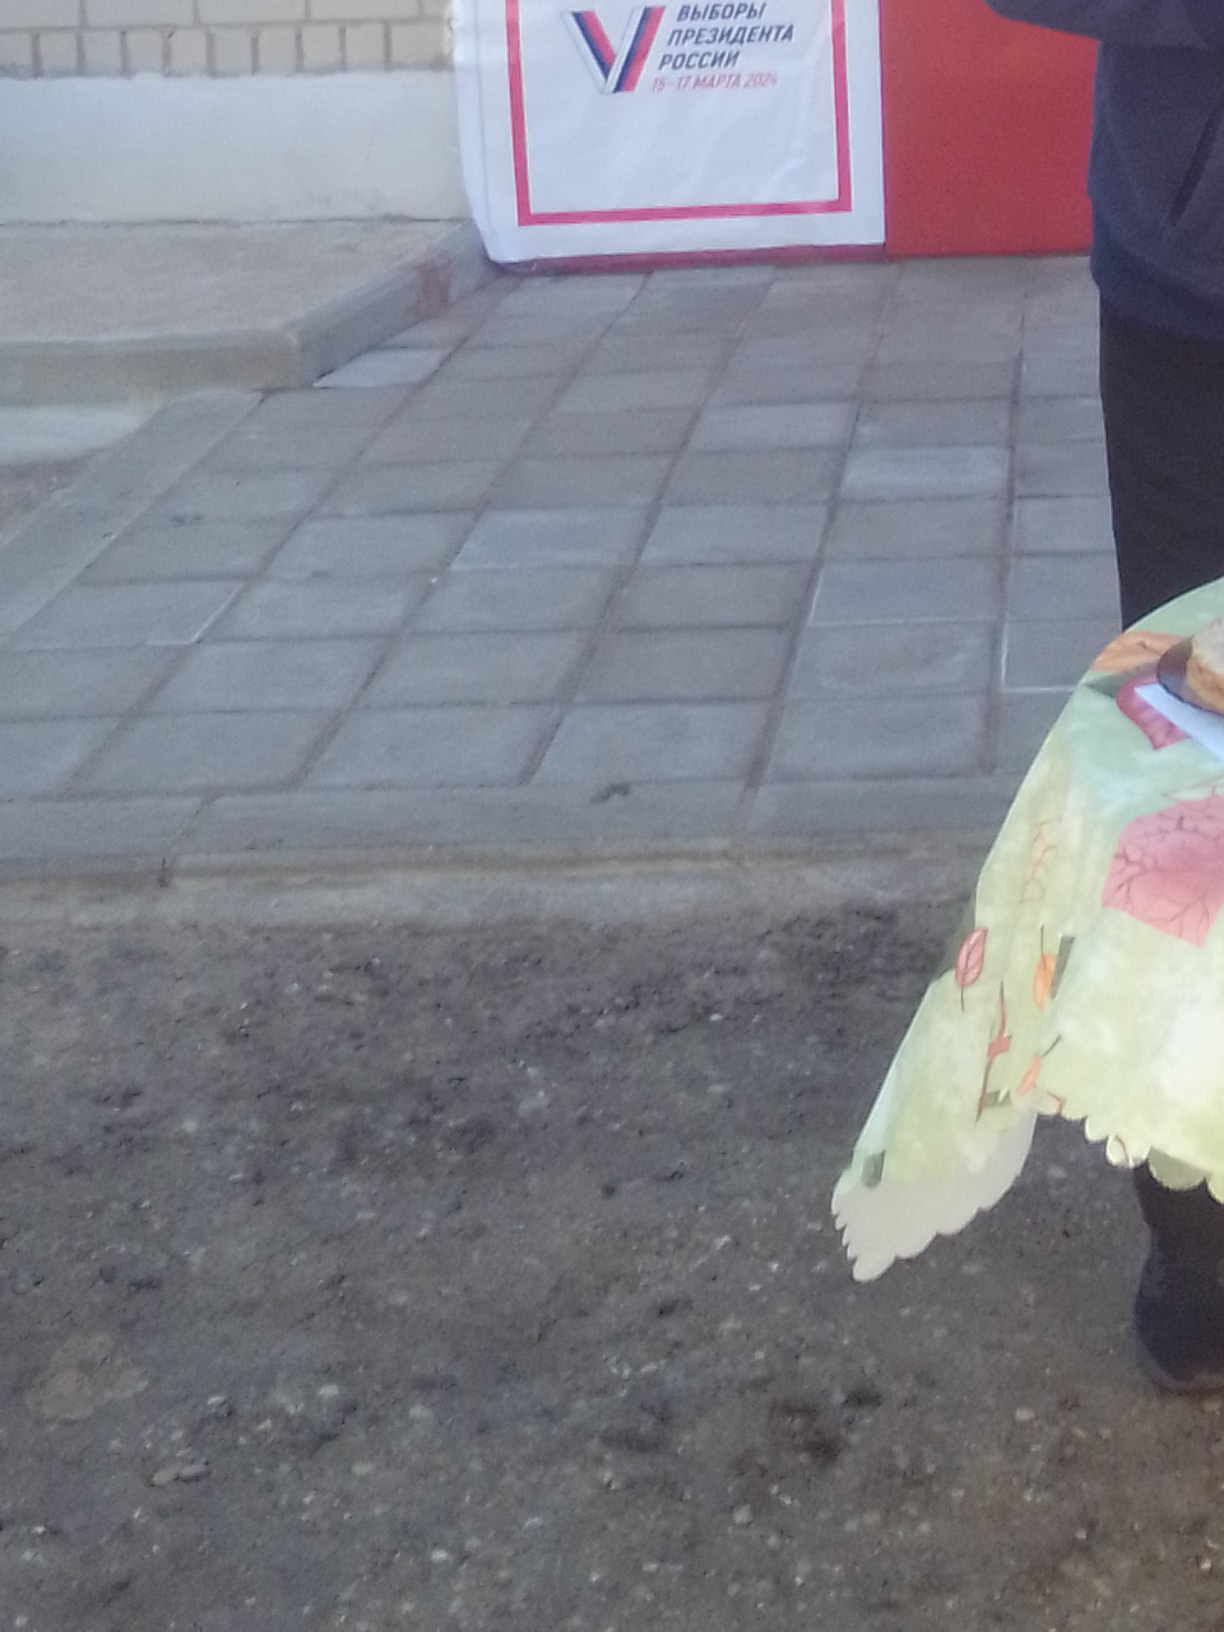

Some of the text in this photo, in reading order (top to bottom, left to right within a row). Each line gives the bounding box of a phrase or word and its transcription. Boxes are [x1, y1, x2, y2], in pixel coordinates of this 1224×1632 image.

[677, 2, 767, 22] ВЫБОРЫ
[667, 24, 794, 46] ПРЕЗИДЕНТА
[658, 51, 740, 70] РОССИИ
[692, 72, 741, 90] МАРТА
[743, 71, 778, 87] 2024
